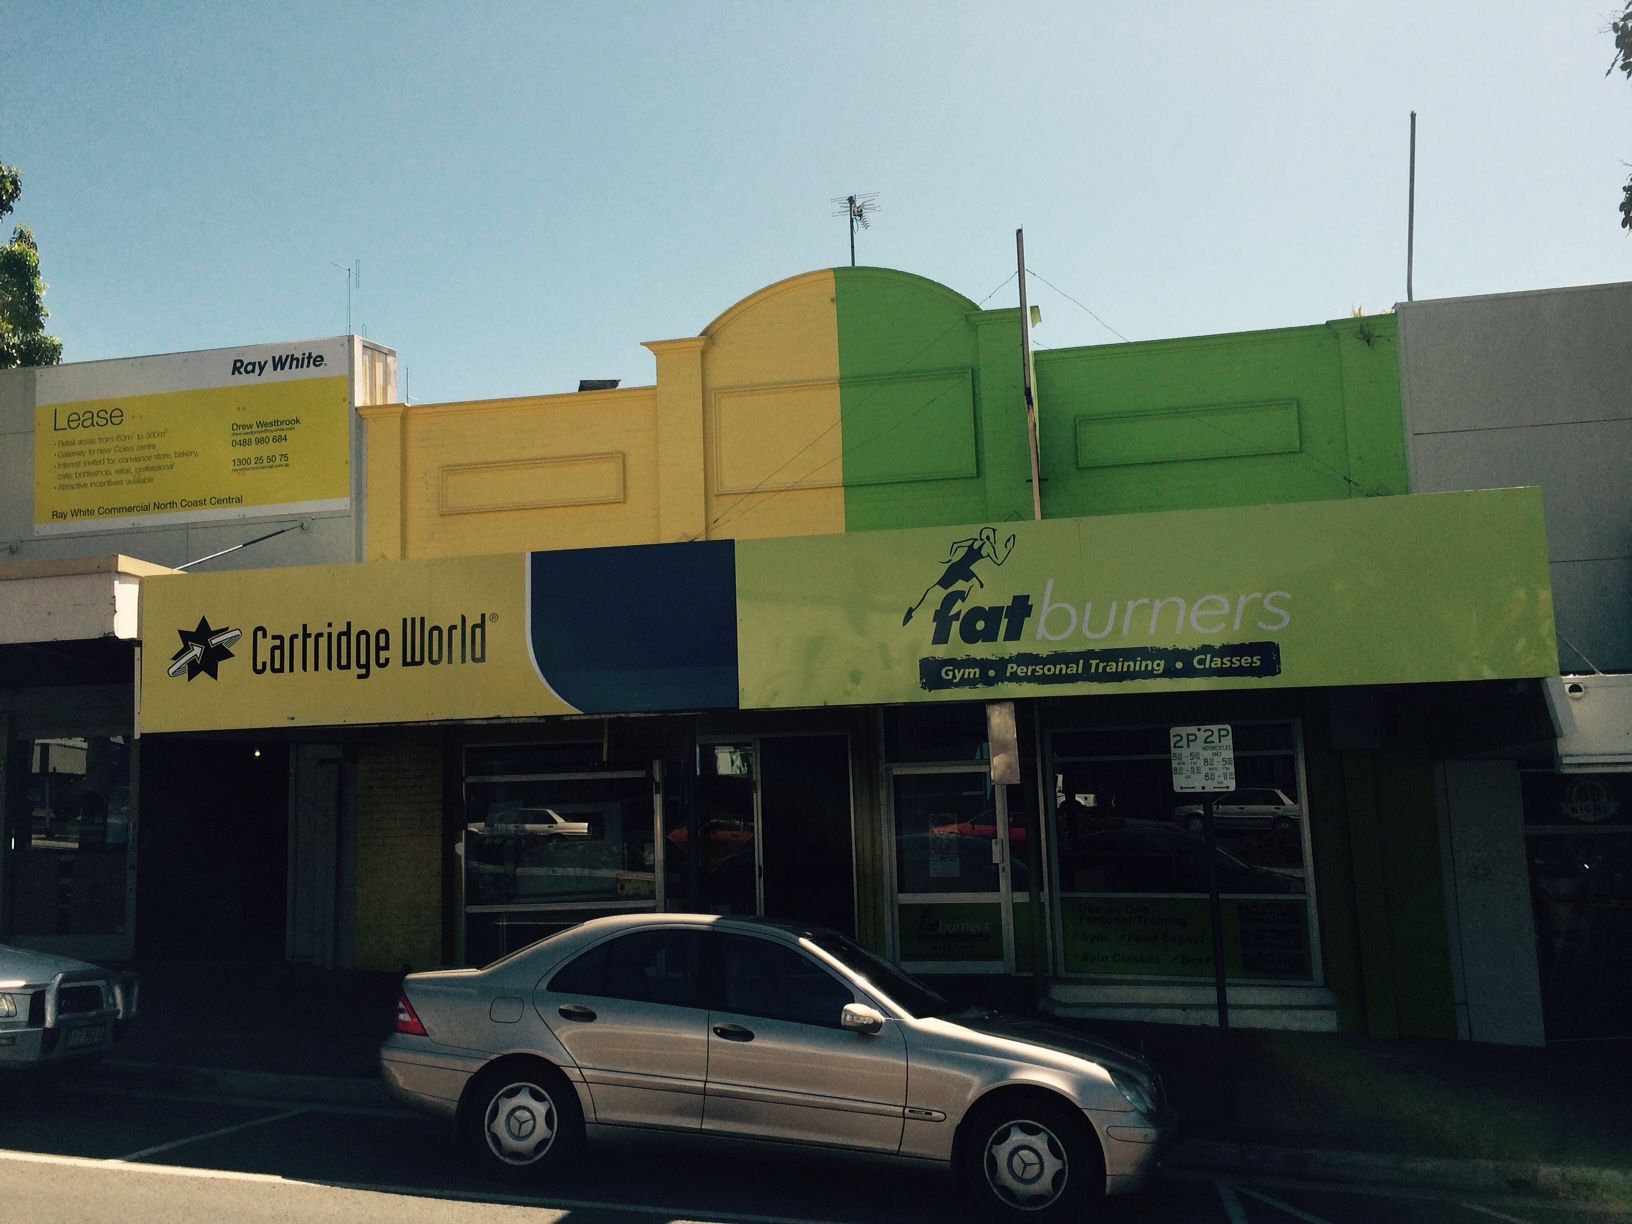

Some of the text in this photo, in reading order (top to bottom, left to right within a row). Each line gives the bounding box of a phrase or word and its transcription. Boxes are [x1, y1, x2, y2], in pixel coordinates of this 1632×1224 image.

[231, 352, 325, 376] Ray White
[53, 407, 124, 432] Lease
[232, 416, 300, 432] Drew Westbrook
[231, 434, 288, 448] 0488 980 684
[232, 454, 288, 467] 1300 25 50 75
[52, 495, 243, 521] Ray White Commercial North Coast Central
[252, 613, 486, 680] Cartridge World
[940, 654, 1262, 684] Gym Personal Training Classes
[1172, 732, 1198, 748] 2P
[1203, 728, 1230, 744] 2P
[1079, 914, 1188, 928] Personal Training
[1080, 932, 1108, 944] Gym
